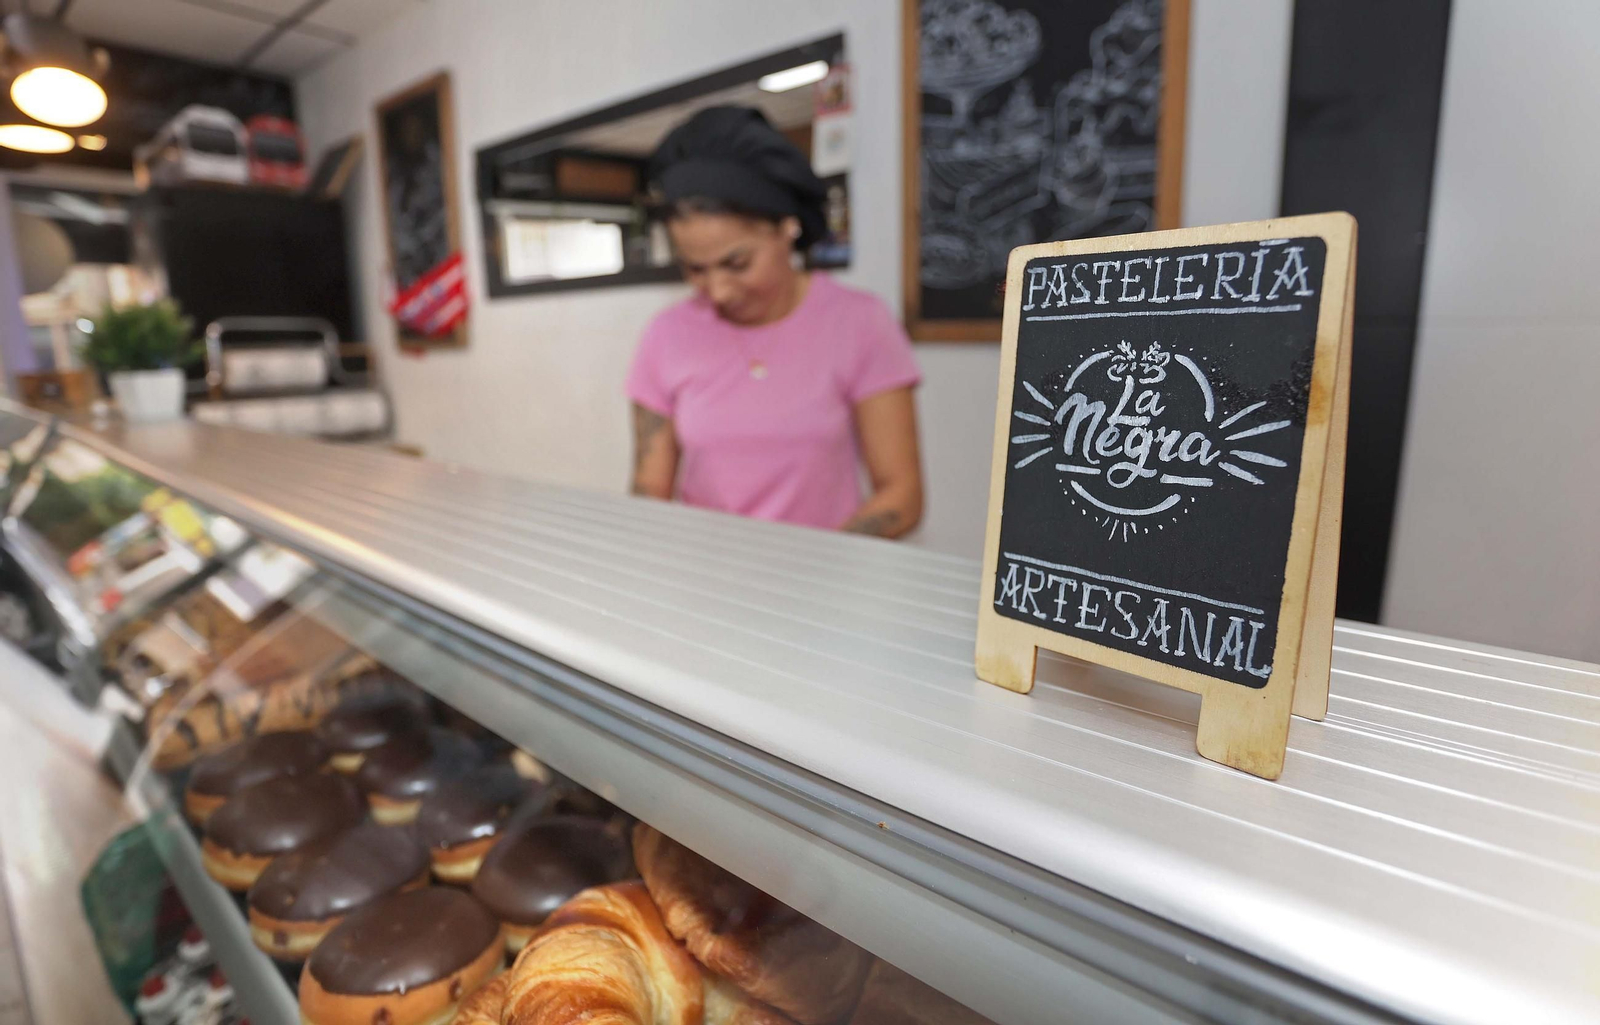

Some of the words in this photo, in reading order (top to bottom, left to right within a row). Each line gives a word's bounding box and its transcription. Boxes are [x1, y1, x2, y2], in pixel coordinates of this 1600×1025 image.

[1022, 239, 1314, 310] PASTELERÍA
[1106, 374, 1166, 426] La
[993, 562, 1272, 679] ARTESANAL
